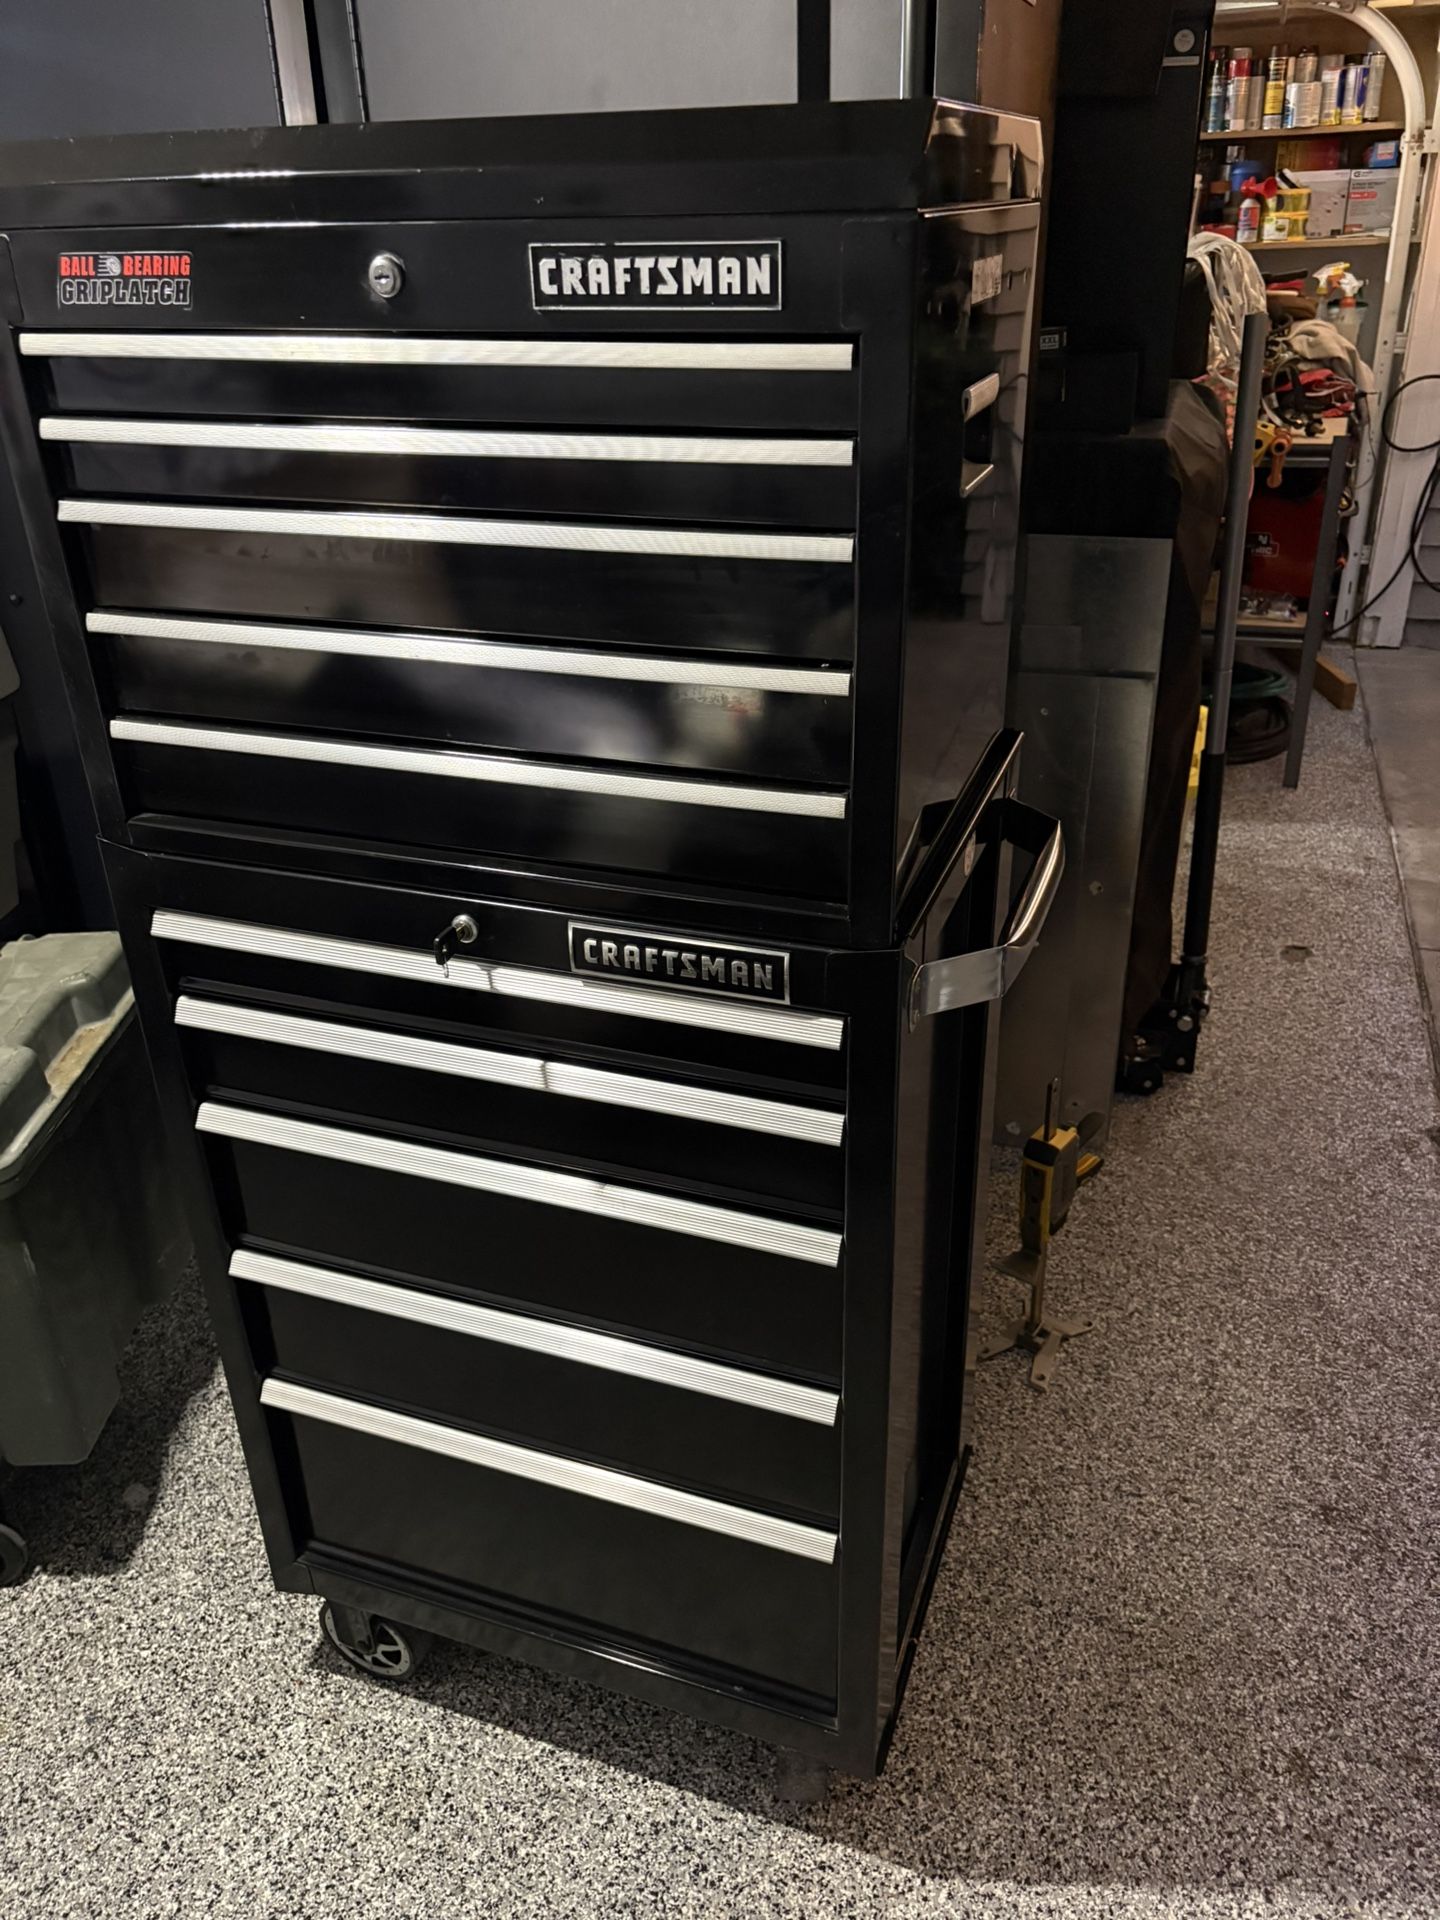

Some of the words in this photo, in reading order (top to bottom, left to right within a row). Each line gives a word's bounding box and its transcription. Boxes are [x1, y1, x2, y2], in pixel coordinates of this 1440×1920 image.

[60, 256, 95, 276] BALL
[123, 255, 190, 276] BEARING
[538, 255, 771, 295] CRAFTSMAN
[61, 278, 191, 305] GRIPLATCH
[583, 937, 773, 990] CRAFTSMAN
